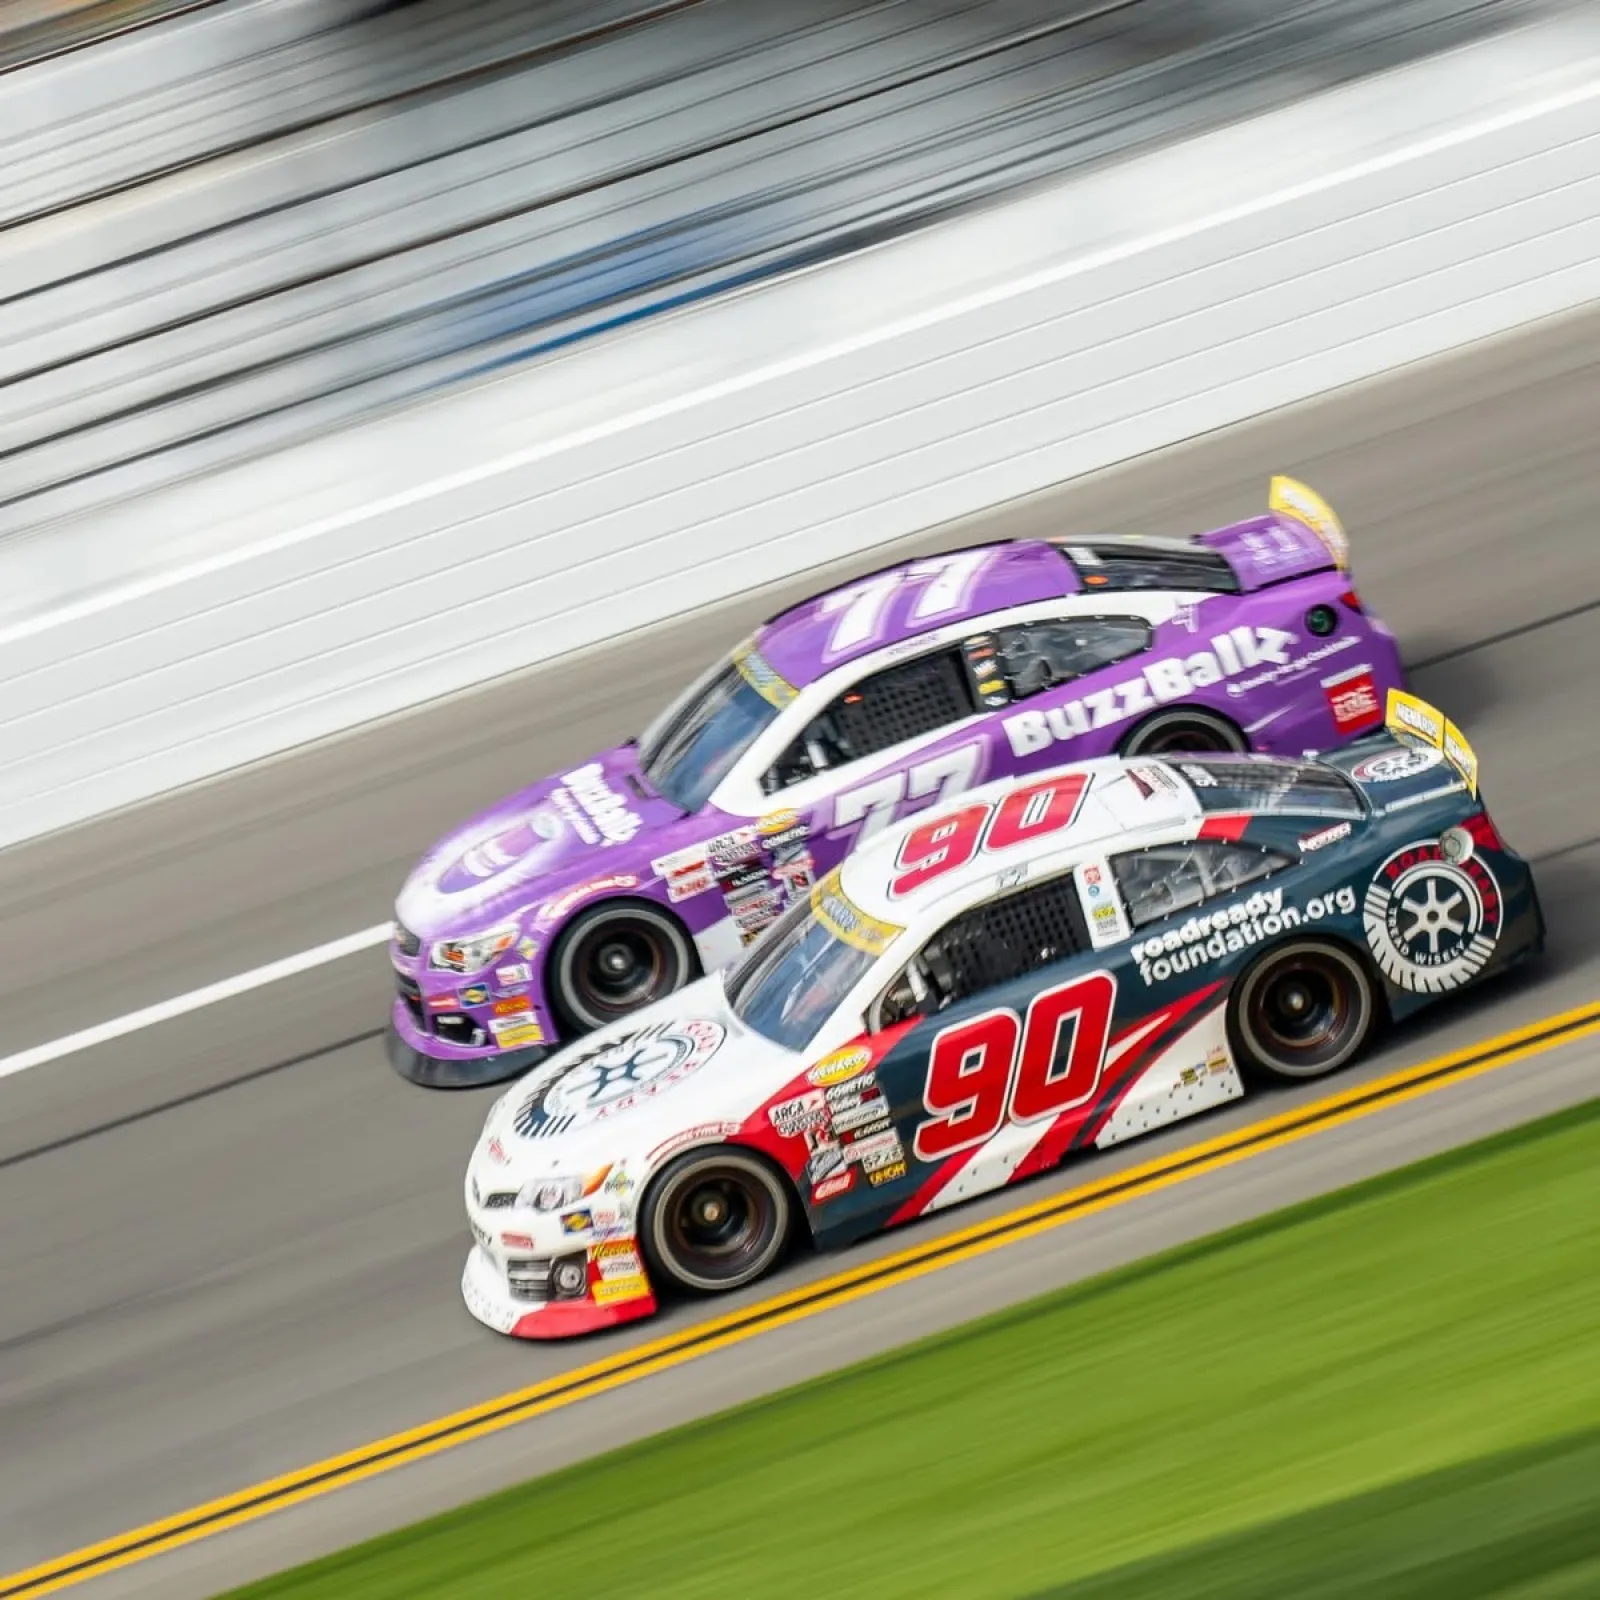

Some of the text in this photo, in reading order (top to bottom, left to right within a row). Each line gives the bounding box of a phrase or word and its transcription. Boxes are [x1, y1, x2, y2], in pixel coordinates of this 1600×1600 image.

[819, 550, 994, 656] 77
[1002, 626, 1296, 757] BuzzBallz
[888, 772, 1096, 900] 90
[1130, 888, 1283, 964] roadready
[1139, 886, 1356, 986] foundation.org
[774, 1101, 805, 1122] ARCA
[914, 969, 1117, 1162] 90
